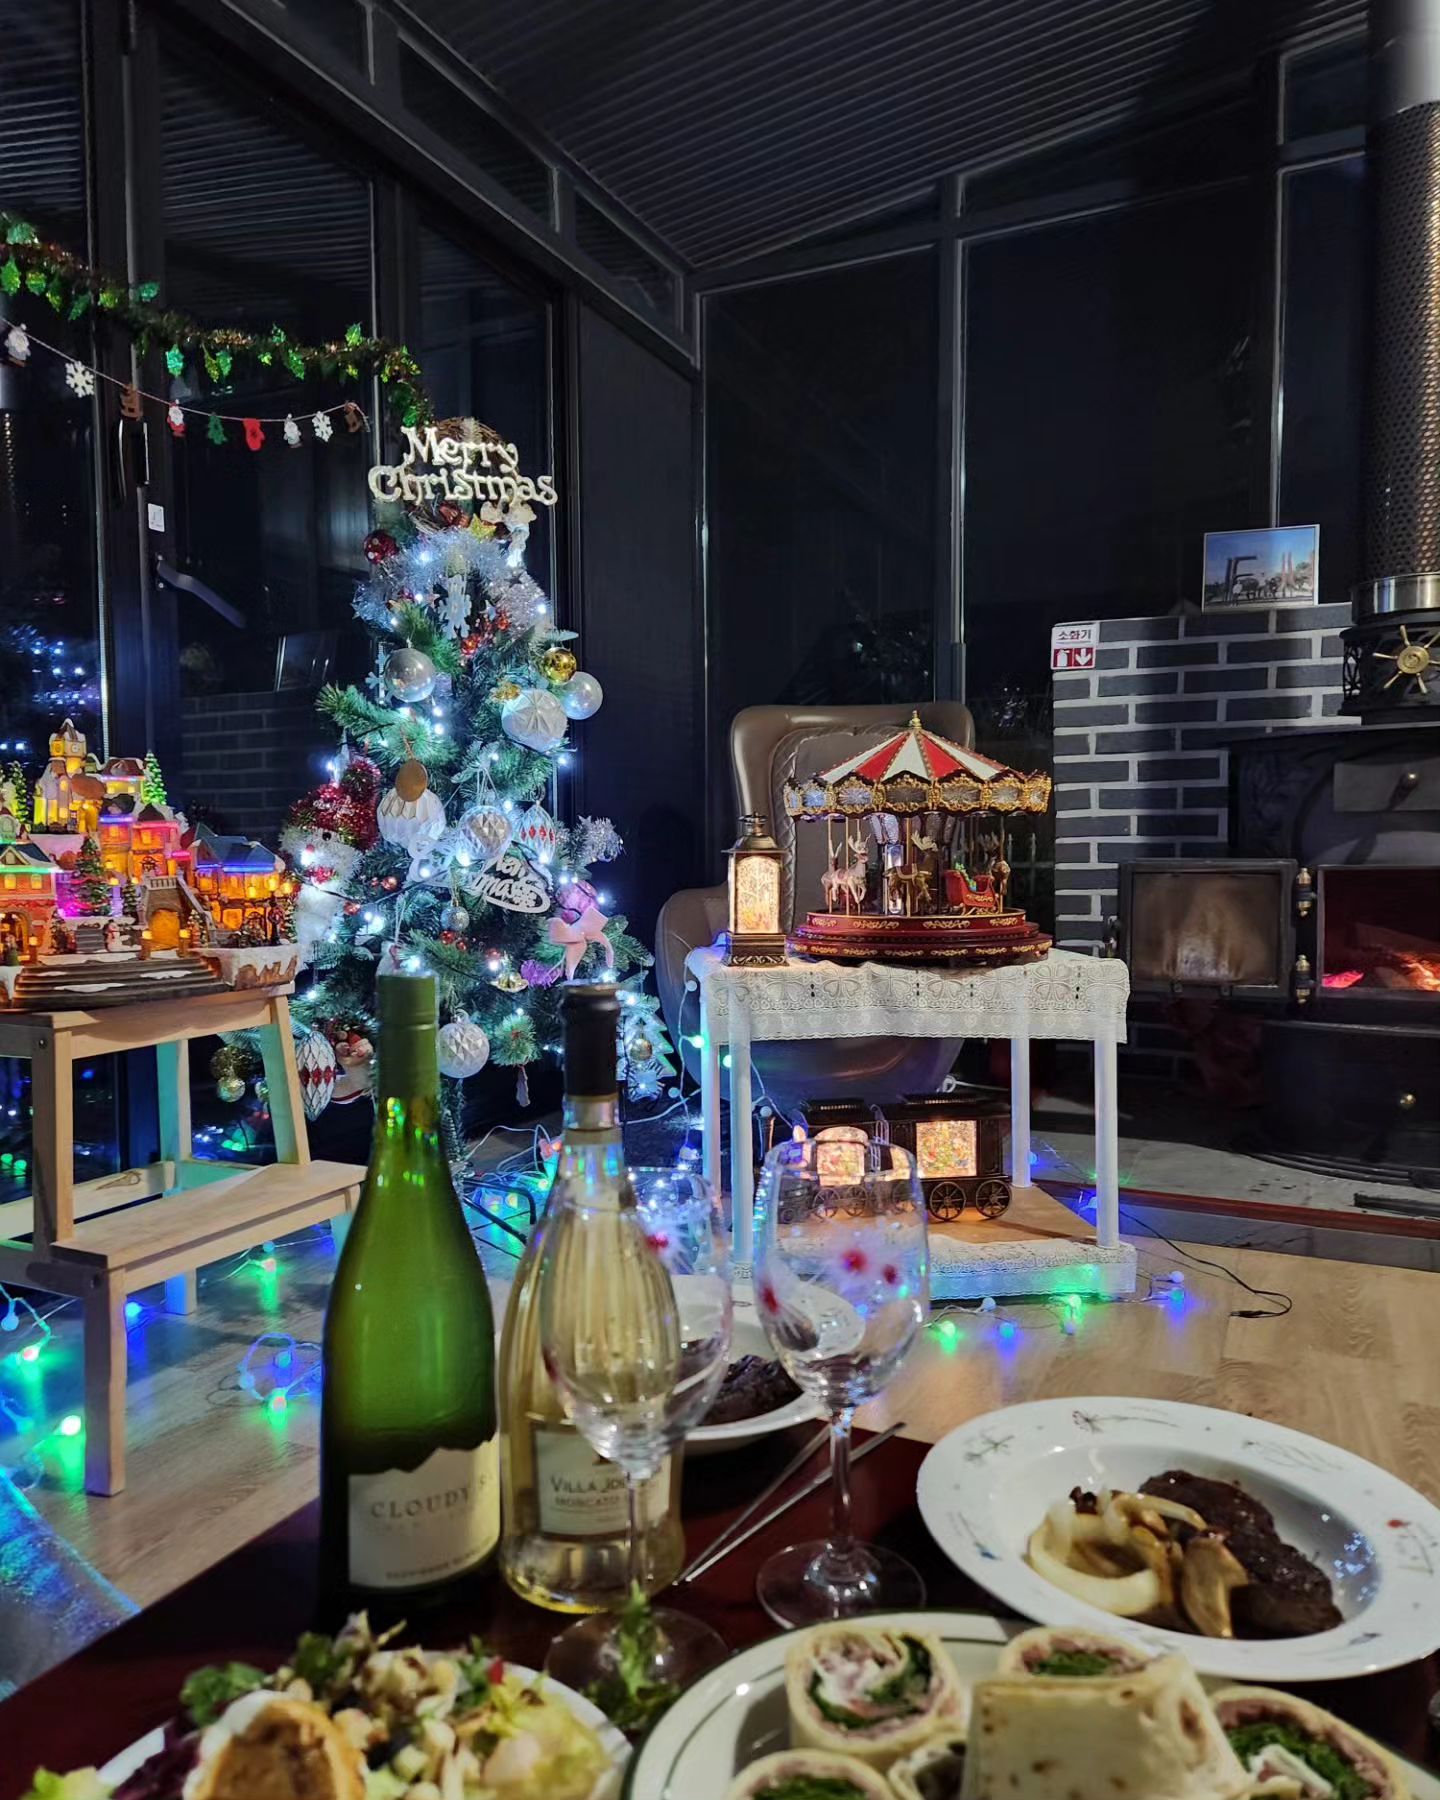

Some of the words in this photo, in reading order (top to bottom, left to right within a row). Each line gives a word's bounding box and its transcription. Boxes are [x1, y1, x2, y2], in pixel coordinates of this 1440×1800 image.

[401, 426, 518, 473] Merry
[368, 465, 558, 506] Christmas
[1058, 629, 1092, 640] 소화기
